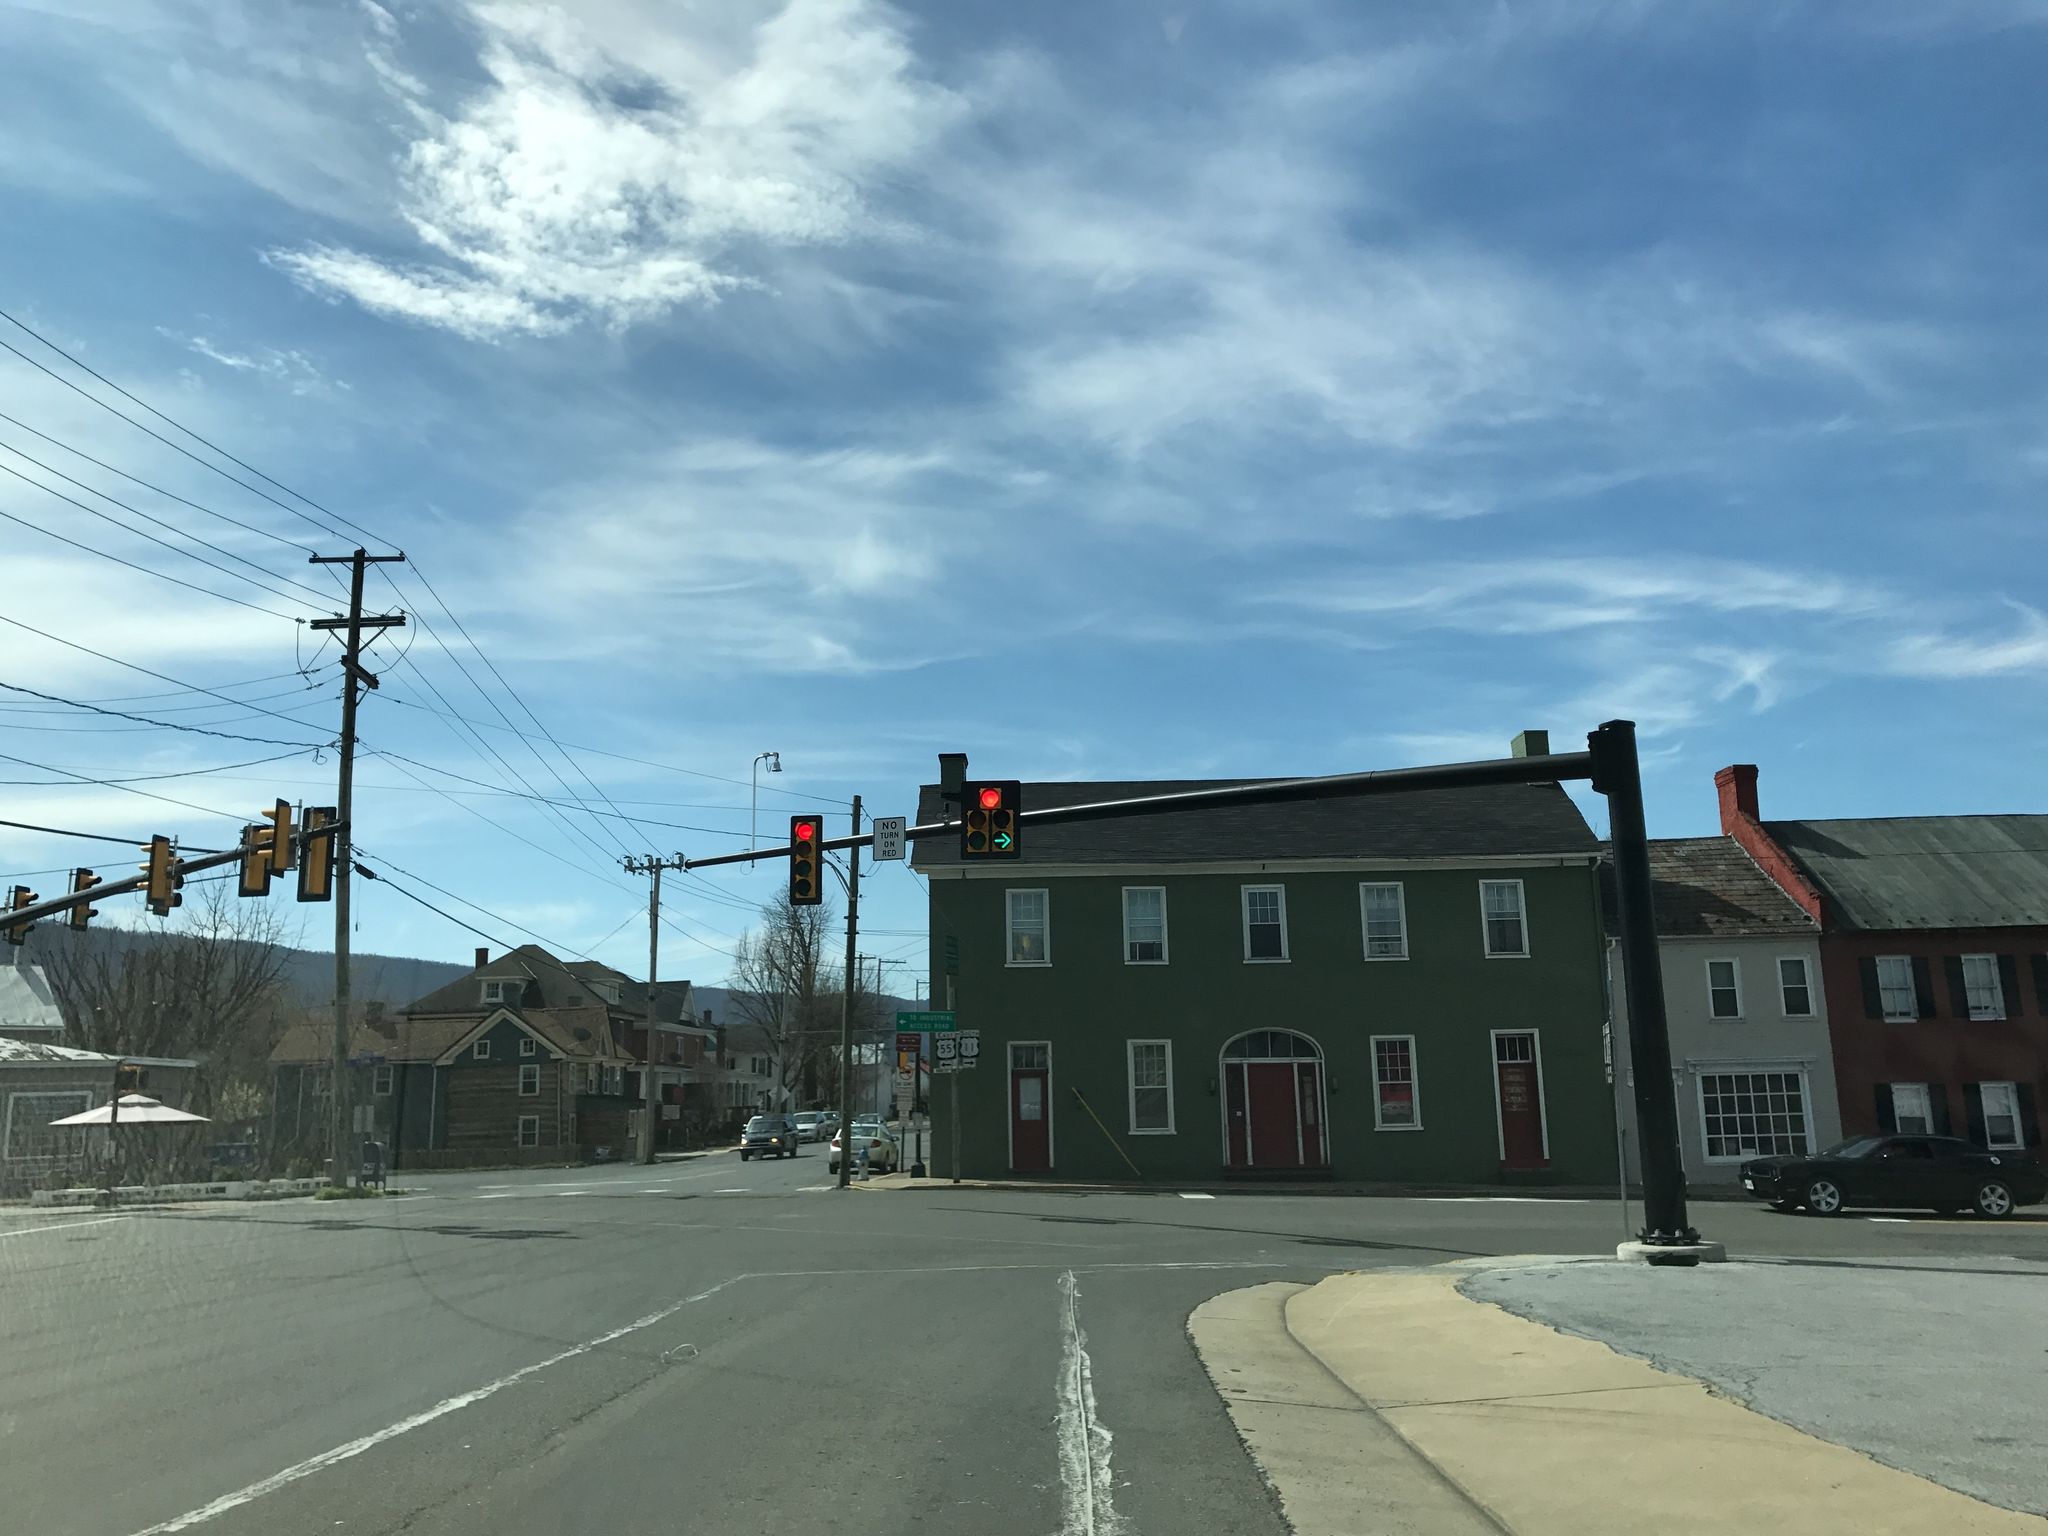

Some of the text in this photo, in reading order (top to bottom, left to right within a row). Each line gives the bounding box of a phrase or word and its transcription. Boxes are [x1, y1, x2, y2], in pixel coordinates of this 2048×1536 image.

[882, 821, 897, 829] NO
[940, 1044, 952, 1054] 55
[964, 1042, 975, 1052] 11
